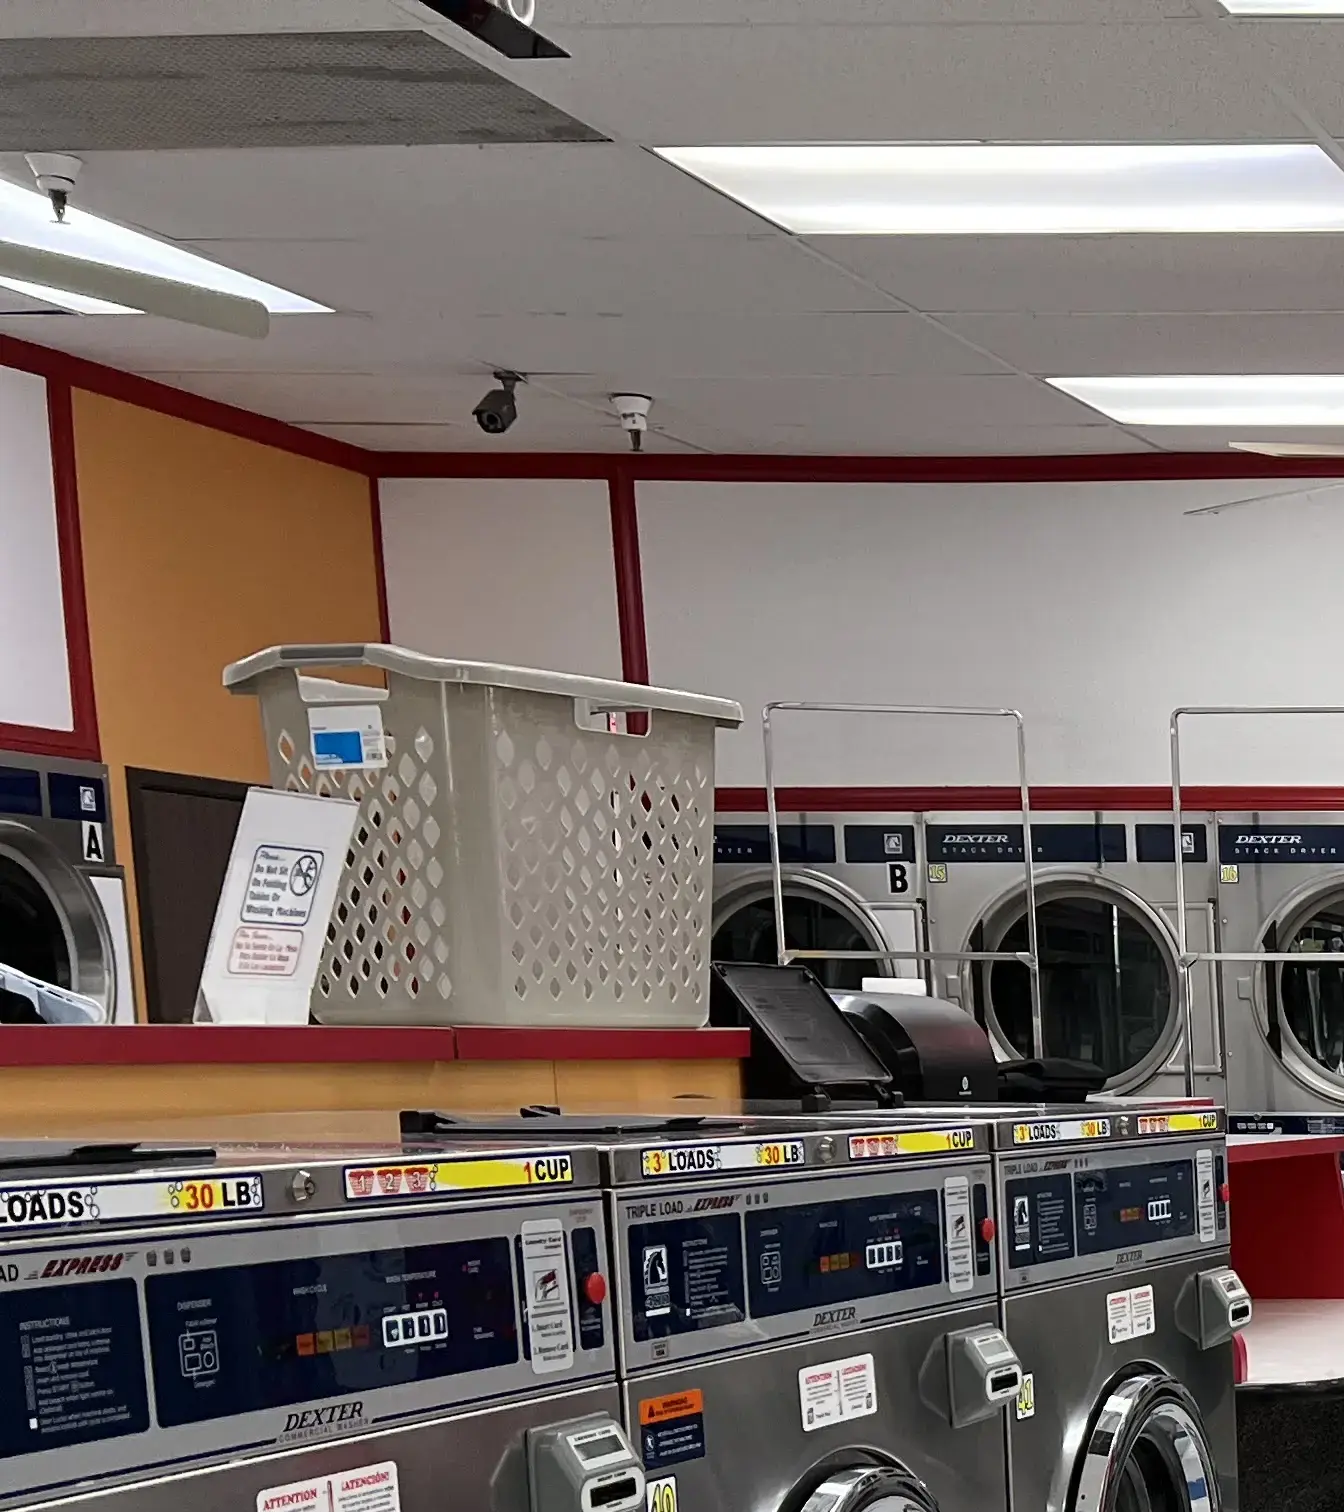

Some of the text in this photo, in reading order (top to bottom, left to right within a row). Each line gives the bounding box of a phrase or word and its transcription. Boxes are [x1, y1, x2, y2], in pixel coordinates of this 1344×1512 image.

[86, 824, 102, 860] A
[942, 834, 1009, 844] DEXTER
[1235, 835, 1302, 844] DEXTER
[889, 863, 908, 893] B
[931, 865, 945, 880] 15
[1222, 865, 1237, 881] 16
[1019, 1126, 1025, 1141] 3
[1029, 1125, 1056, 1140] LOADS
[1097, 1120, 1107, 1134] LB
[1203, 1114, 1216, 1127] CUP
[952, 1132, 972, 1149] CUP
[653, 1143, 799, 1173] 3 LOADS 30 LB
[524, 1162, 531, 1183] 1
[535, 1158, 569, 1181] CUP
[0, 1181, 250, 1223] OADS 30 LB
[626, 1195, 739, 1219] TRIPLE LOAD EXPRESS
[40, 1252, 125, 1278] EXPRESS
[813, 1307, 856, 1327] DEXTER
[283, 1401, 363, 1432] DEXTER
[279, 1424, 332, 1443] COMMERCIAL
[263, 1488, 318, 1511] ATTENTION
